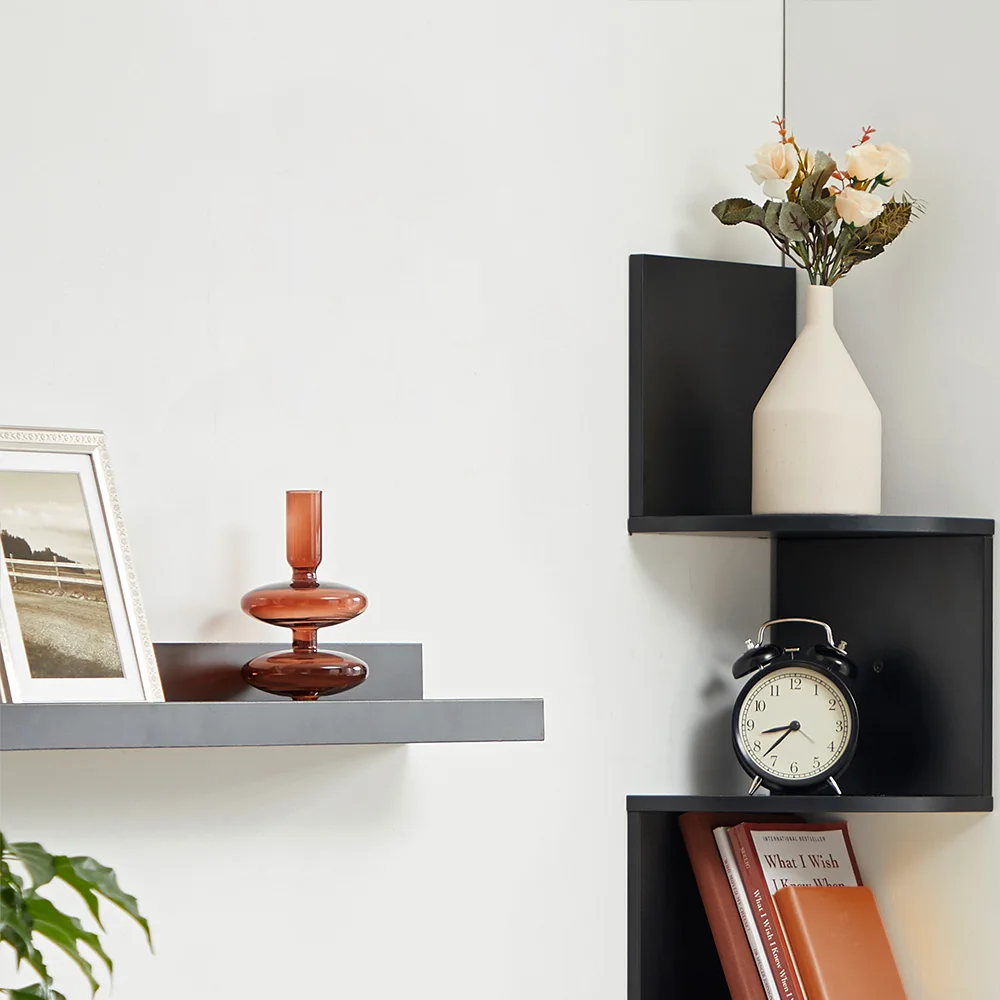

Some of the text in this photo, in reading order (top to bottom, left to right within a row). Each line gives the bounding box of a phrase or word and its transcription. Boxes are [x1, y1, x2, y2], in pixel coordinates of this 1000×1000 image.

[789, 679, 802, 690] 12
[814, 685, 819, 696] 1
[770, 685, 779, 697] 11
[754, 700, 766, 712] 10
[828, 699, 836, 711] 2
[747, 719, 755, 731] 9
[835, 721, 843, 733] 3
[753, 740, 761, 752] 8
[827, 741, 835, 752] 4
[771, 756, 778, 767] 7
[812, 757, 820, 768] 5
[790, 762, 798, 774] 6
[764, 853, 840, 869] What I Wish
[753, 889, 764, 912] What
[763, 919, 774, 941] Wish
[771, 947, 781, 968] Knew
[779, 969, 789, 992] When
